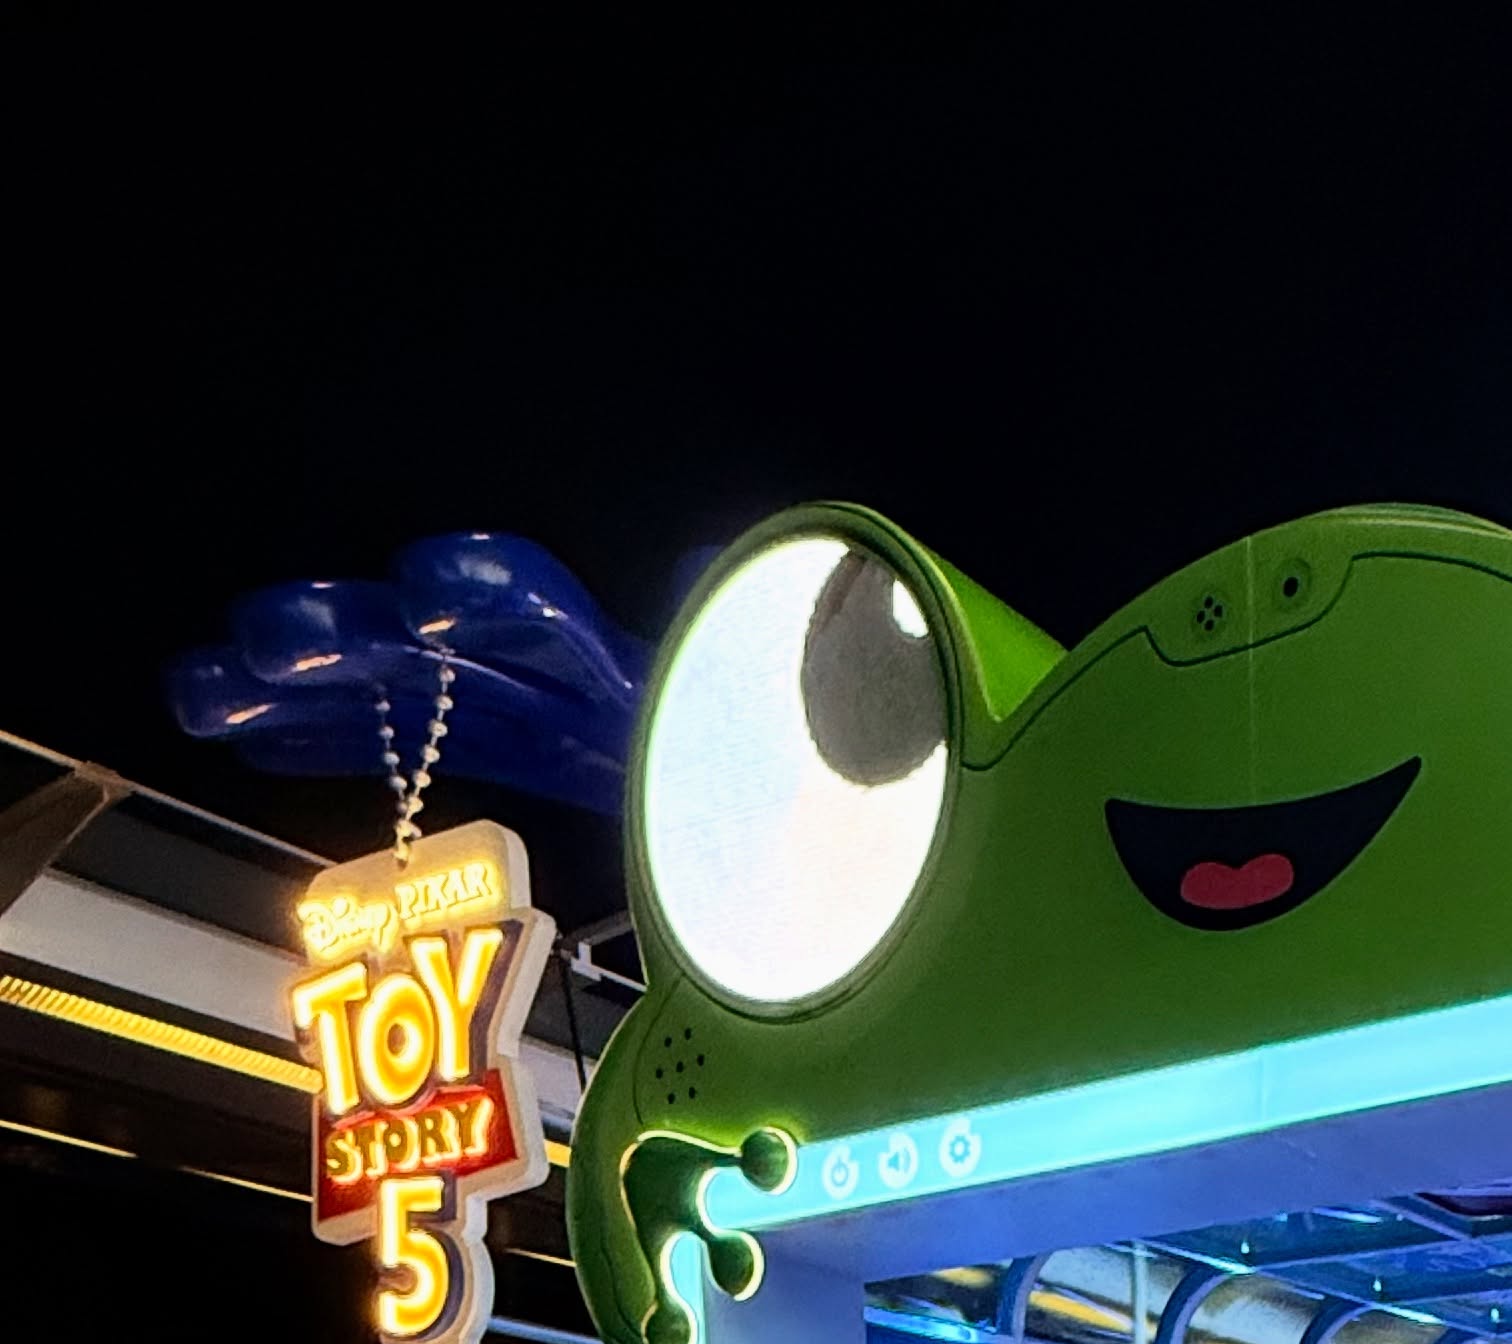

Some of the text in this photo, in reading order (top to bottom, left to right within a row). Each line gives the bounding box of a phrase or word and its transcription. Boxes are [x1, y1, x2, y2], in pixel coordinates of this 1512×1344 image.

[297, 862, 493, 952] Disney PIXAR
[292, 929, 503, 1116] TOY
[325, 1097, 494, 1183] STORY
[378, 1177, 449, 1336] 5
